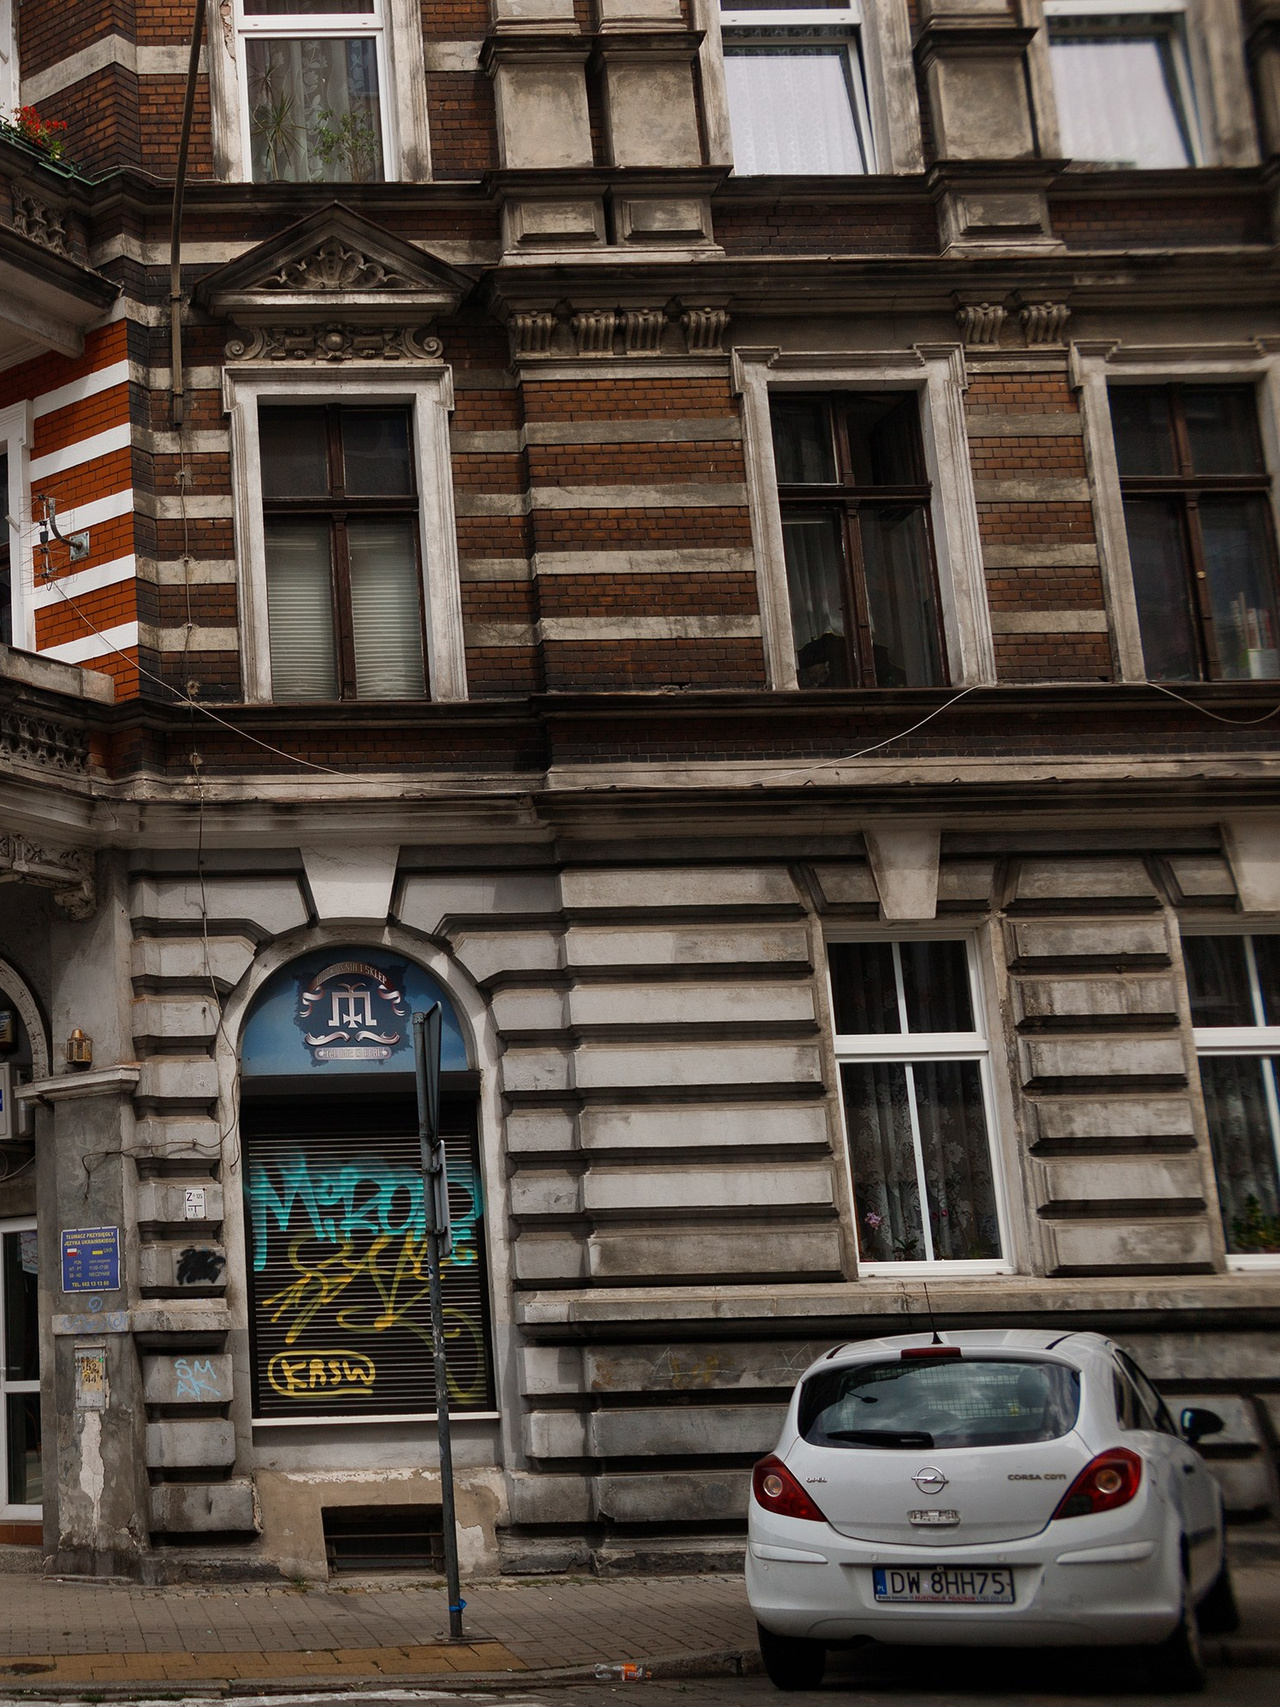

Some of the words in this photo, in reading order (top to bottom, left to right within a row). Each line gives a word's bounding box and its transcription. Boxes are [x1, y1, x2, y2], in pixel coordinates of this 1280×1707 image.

[364, 965, 387, 984] SKLEP
[186, 1192, 193, 1202] Z
[890, 1571, 920, 1594] DW
[930, 1571, 1005, 1595] 8HH75
